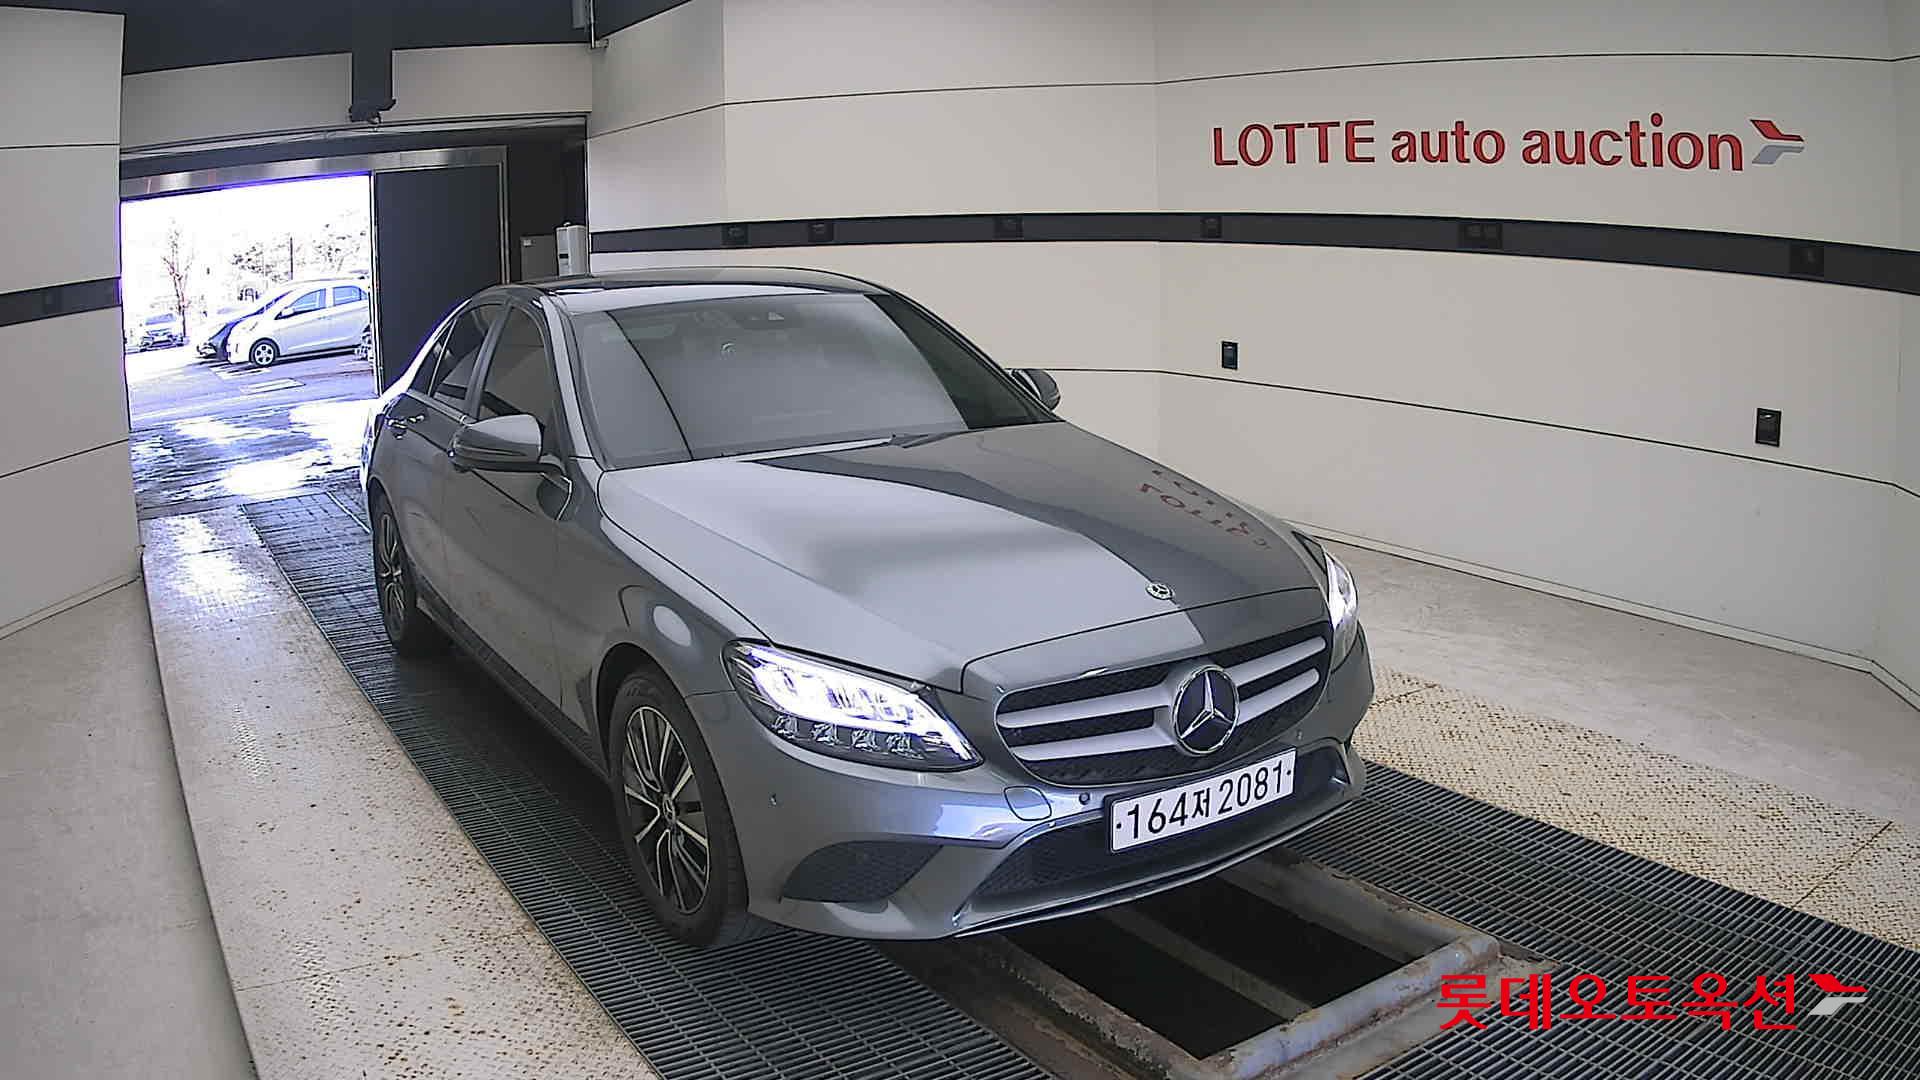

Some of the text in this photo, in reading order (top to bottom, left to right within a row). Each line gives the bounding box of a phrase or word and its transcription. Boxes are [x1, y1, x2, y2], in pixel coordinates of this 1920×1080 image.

[1212, 112, 1744, 171] LOTTE auto auction
[1217, 760, 1283, 816] 2081
